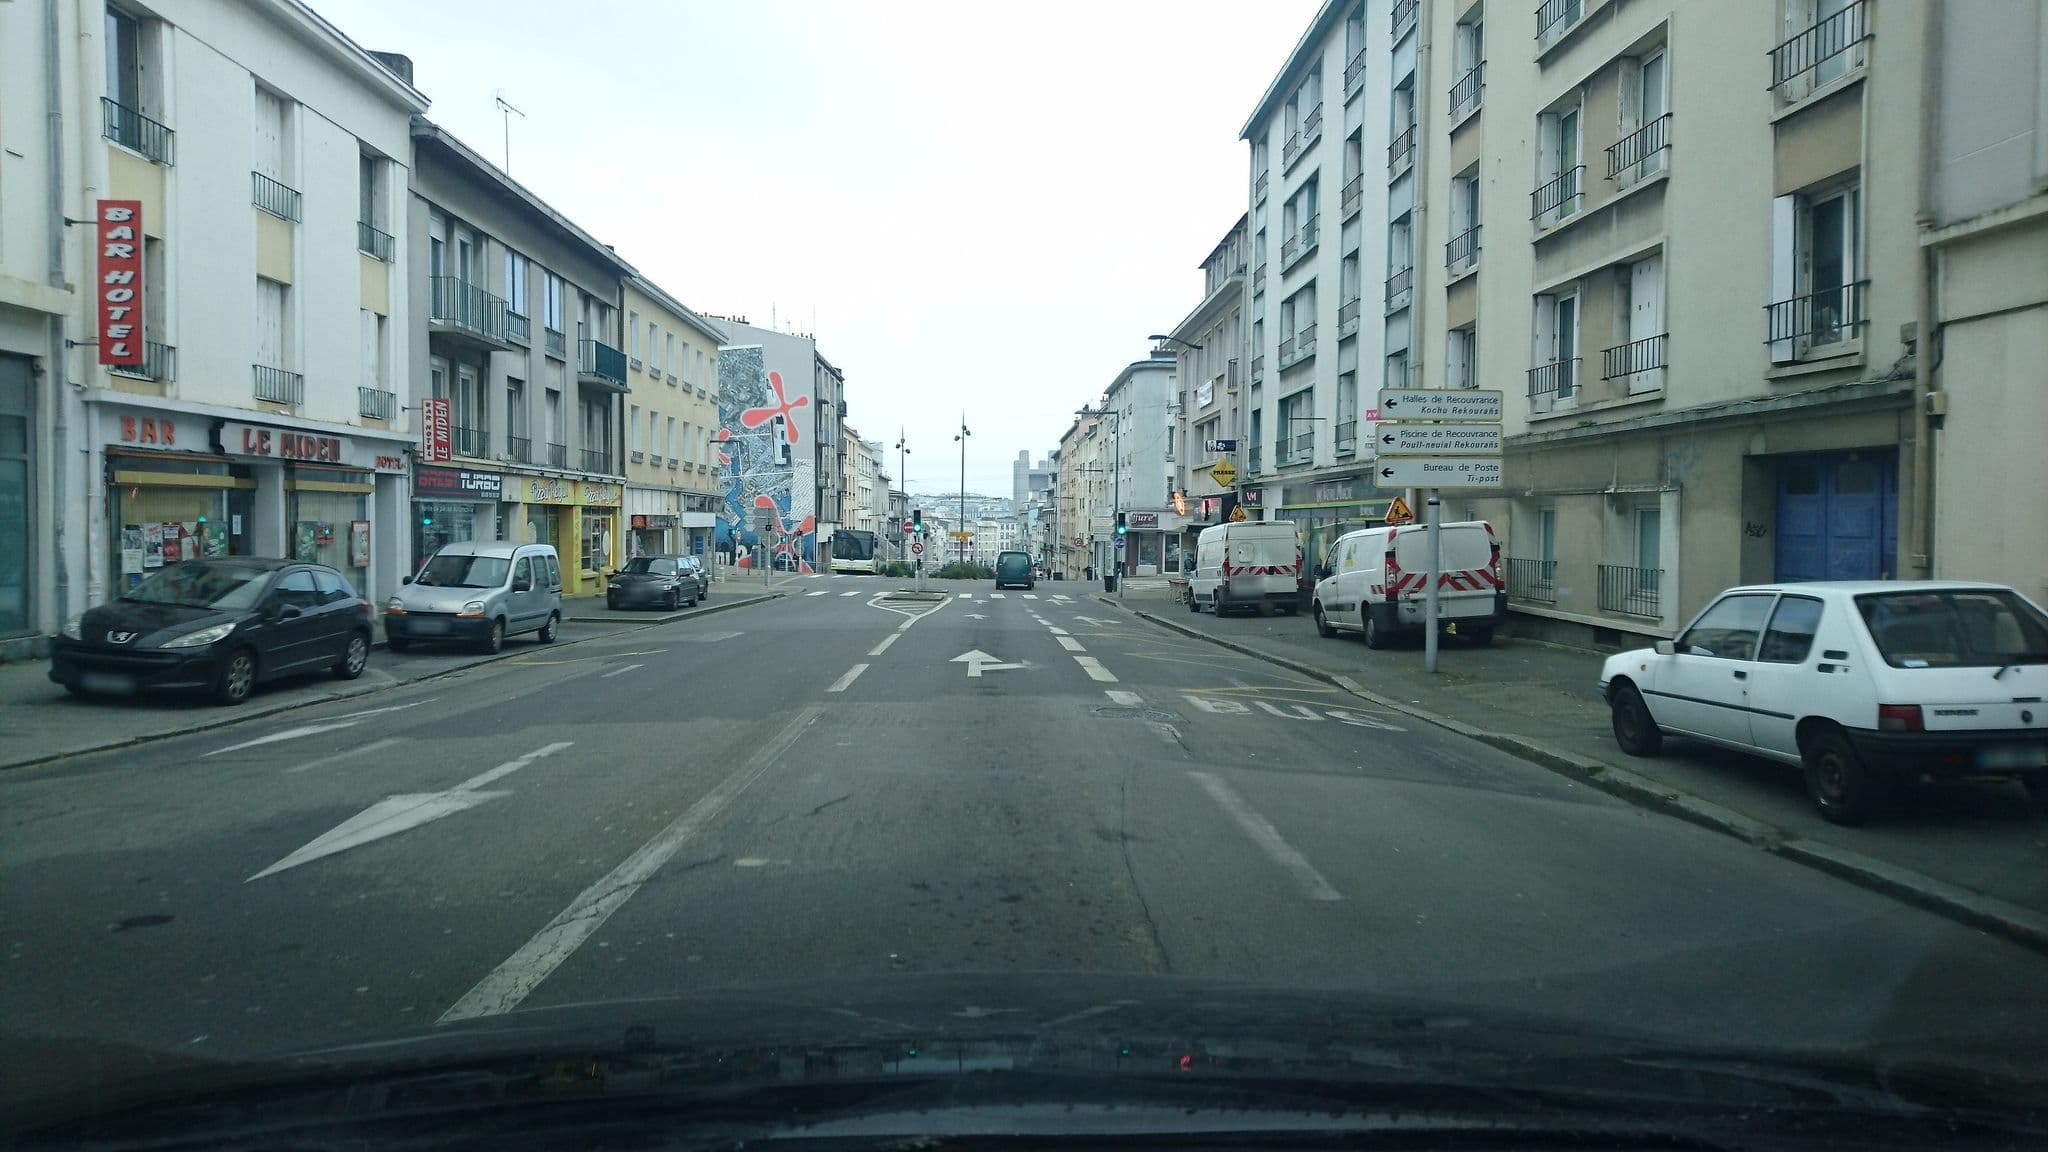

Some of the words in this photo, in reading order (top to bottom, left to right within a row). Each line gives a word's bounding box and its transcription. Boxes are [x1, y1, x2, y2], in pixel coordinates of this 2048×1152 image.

[104, 207, 135, 259] BAR
[104, 270, 135, 357] HOTEL
[1402, 395, 1427, 403] Halles
[1431, 396, 1443, 404] de
[1447, 396, 1499, 405] Recouvrance
[1421, 406, 1448, 414] Kochu
[122, 415, 176, 445] BAR
[435, 401, 448, 442] MIDEN
[1400, 430, 1428, 438] Piscine
[1431, 430, 1443, 438] de
[1446, 430, 1498, 438] Recouvrance
[242, 428, 271, 455] LE
[280, 433, 341, 462] MIDEN
[436, 446, 448, 459] LE
[1423, 464, 1453, 472] Bureau
[1459, 464, 1470, 472] de
[1474, 464, 1499, 472] Poste
[1467, 475, 1499, 484] Ti-post
[1182, 695, 1408, 731] BUS
